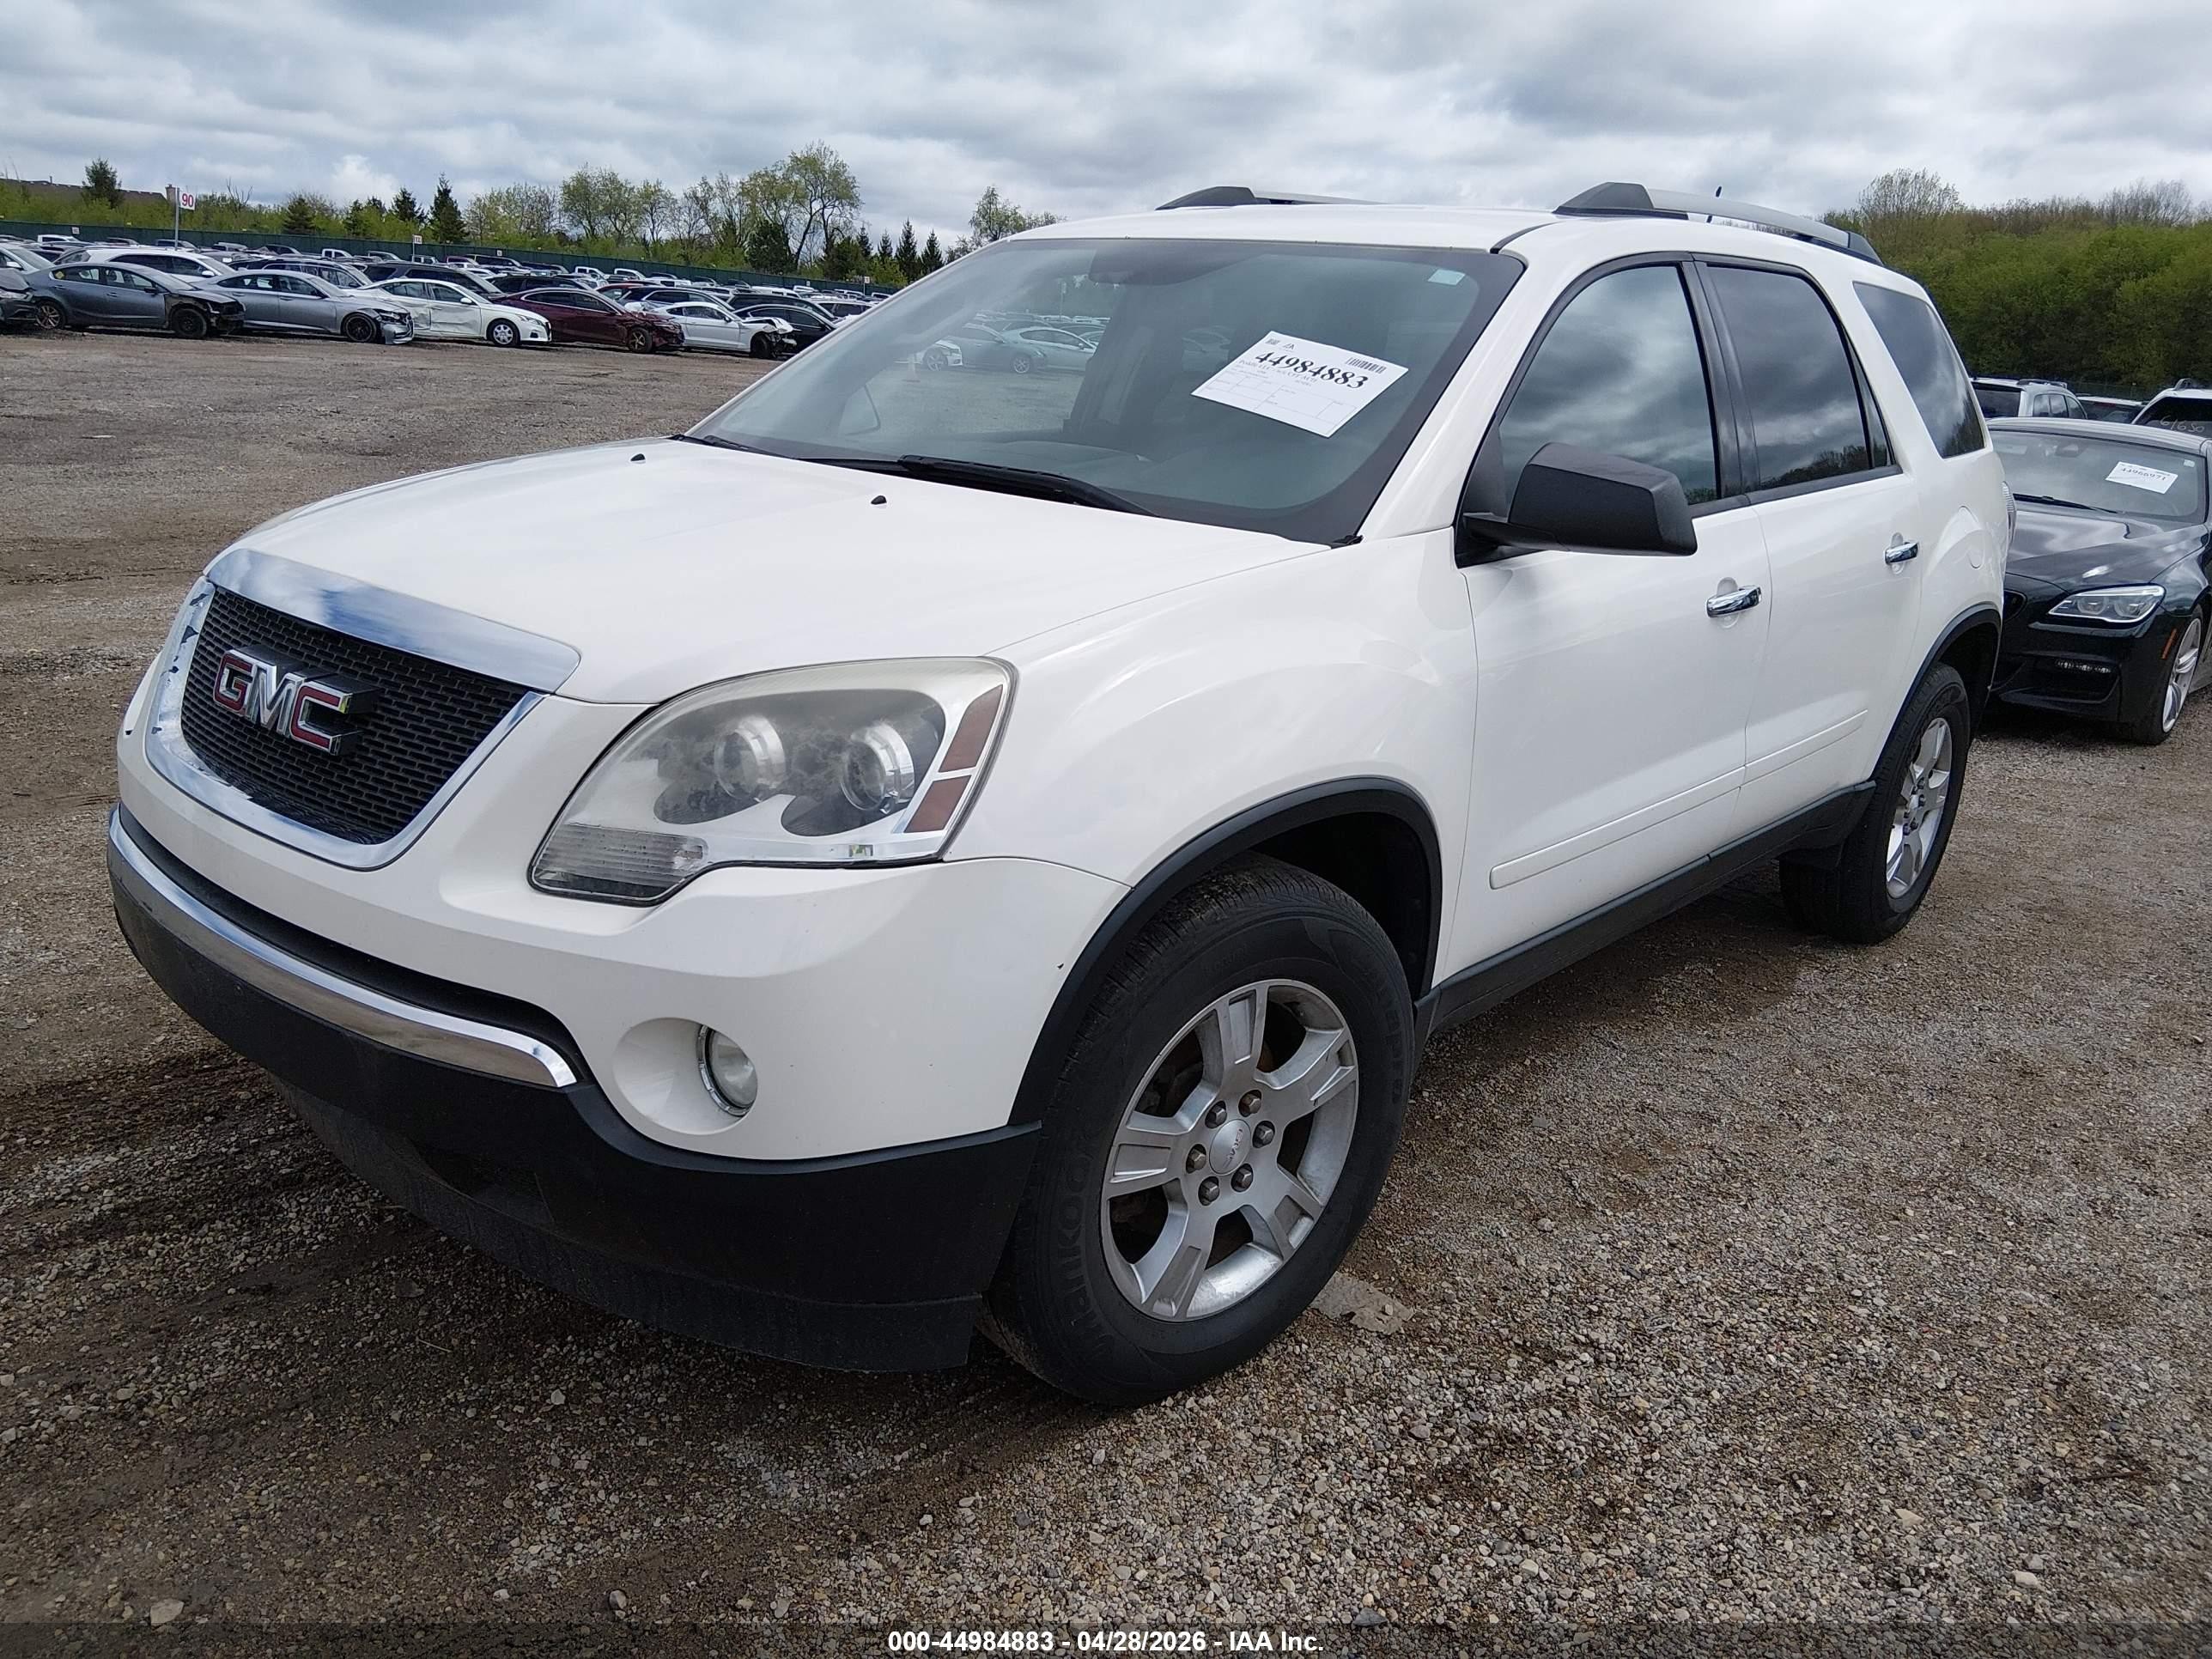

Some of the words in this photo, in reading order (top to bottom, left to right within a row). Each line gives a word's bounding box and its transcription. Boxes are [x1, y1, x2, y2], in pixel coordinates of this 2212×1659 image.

[181, 192, 194, 208] 90
[1255, 351, 1369, 389] 44984883
[213, 649, 354, 757] GMC
